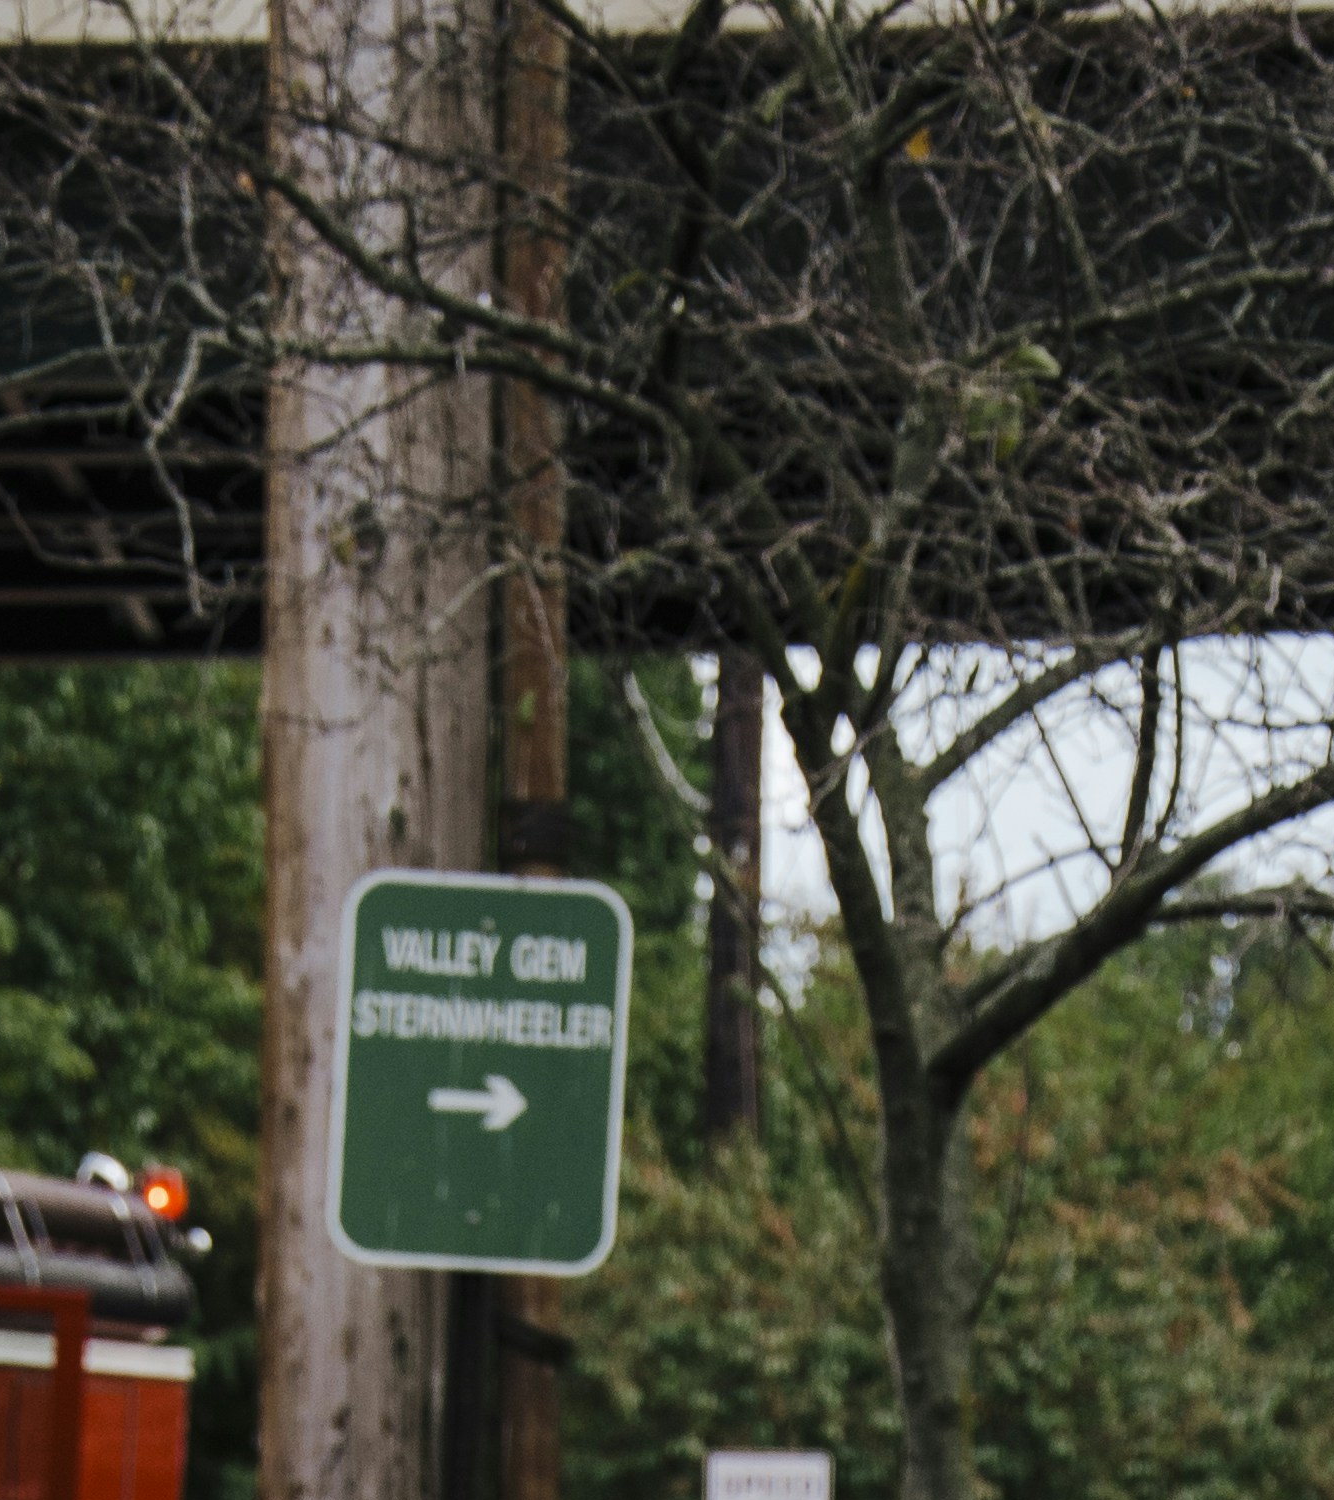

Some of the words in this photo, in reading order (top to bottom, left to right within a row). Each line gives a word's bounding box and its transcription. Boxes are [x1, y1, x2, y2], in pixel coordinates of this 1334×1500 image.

[381, 926, 501, 979] VALLEY
[509, 934, 588, 984] GEM
[351, 990, 614, 1050] STERNWHEELER
